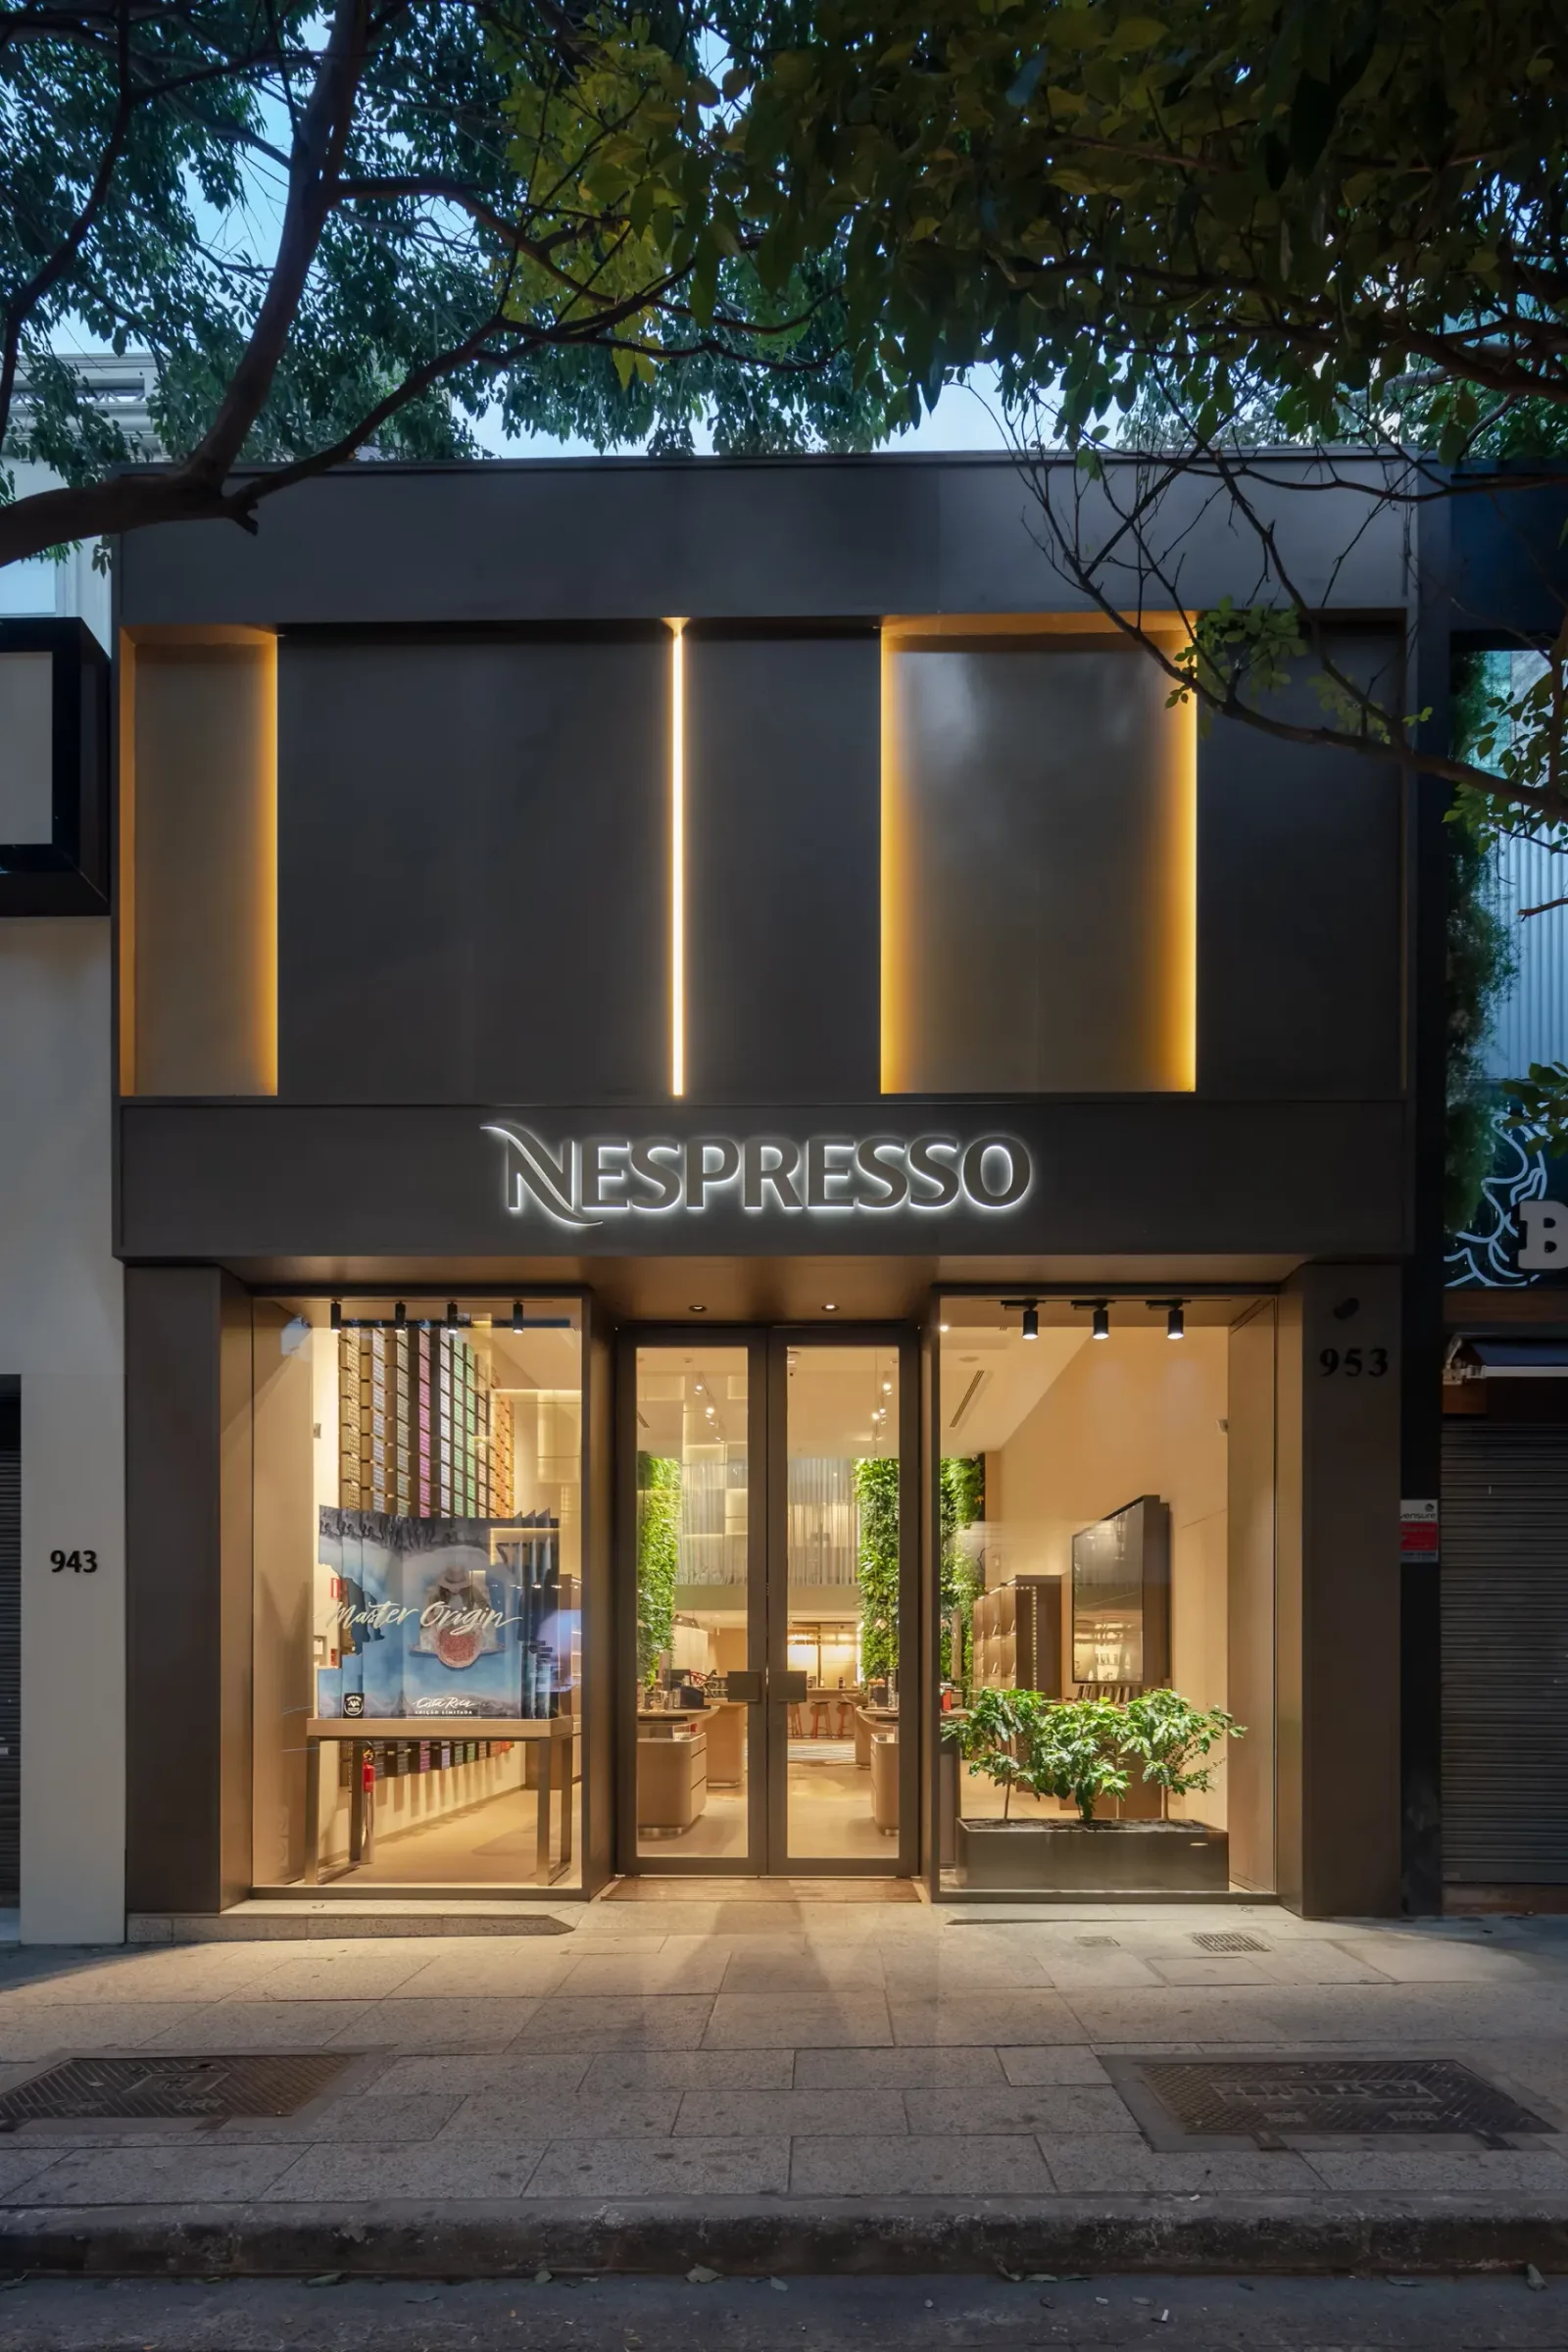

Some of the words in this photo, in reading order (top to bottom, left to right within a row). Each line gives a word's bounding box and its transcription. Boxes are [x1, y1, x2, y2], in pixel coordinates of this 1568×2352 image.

[480, 1121, 1032, 1226] NESPRESSO
[1320, 1348, 1389, 1377] 953
[50, 1549, 98, 1573] 943
[320, 1601, 418, 1630] Master
[420, 1600, 522, 1636] Origin
[413, 1697, 445, 1709] Costa
